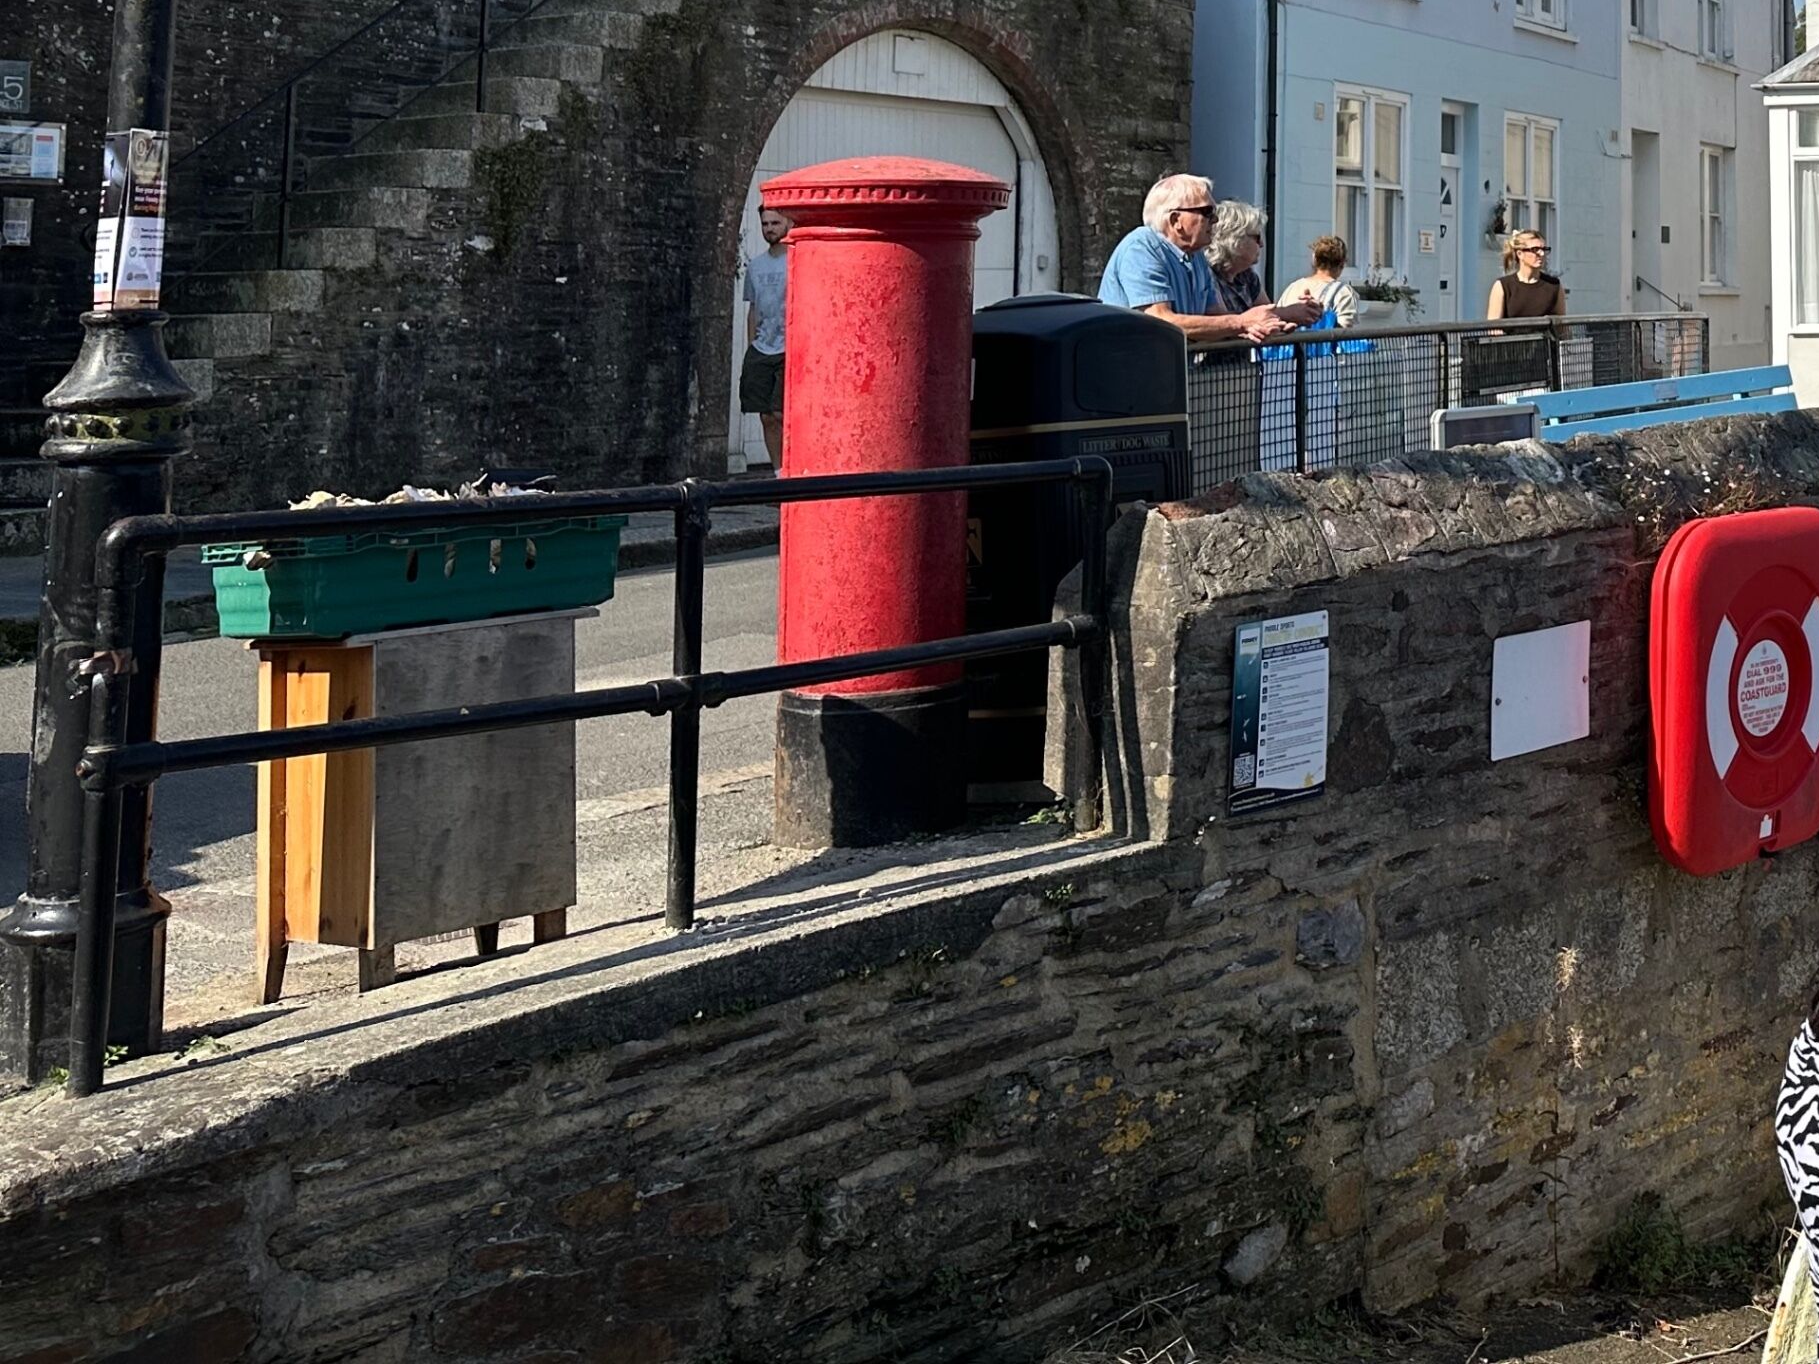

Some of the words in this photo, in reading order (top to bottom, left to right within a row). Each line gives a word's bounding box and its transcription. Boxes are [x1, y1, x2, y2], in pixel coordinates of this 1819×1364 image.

[0, 76, 24, 100] 5
[1746, 668, 1762, 678] DIAL
[1763, 663, 1782, 675] 999
[1740, 682, 1786, 702] COASTGUARD
